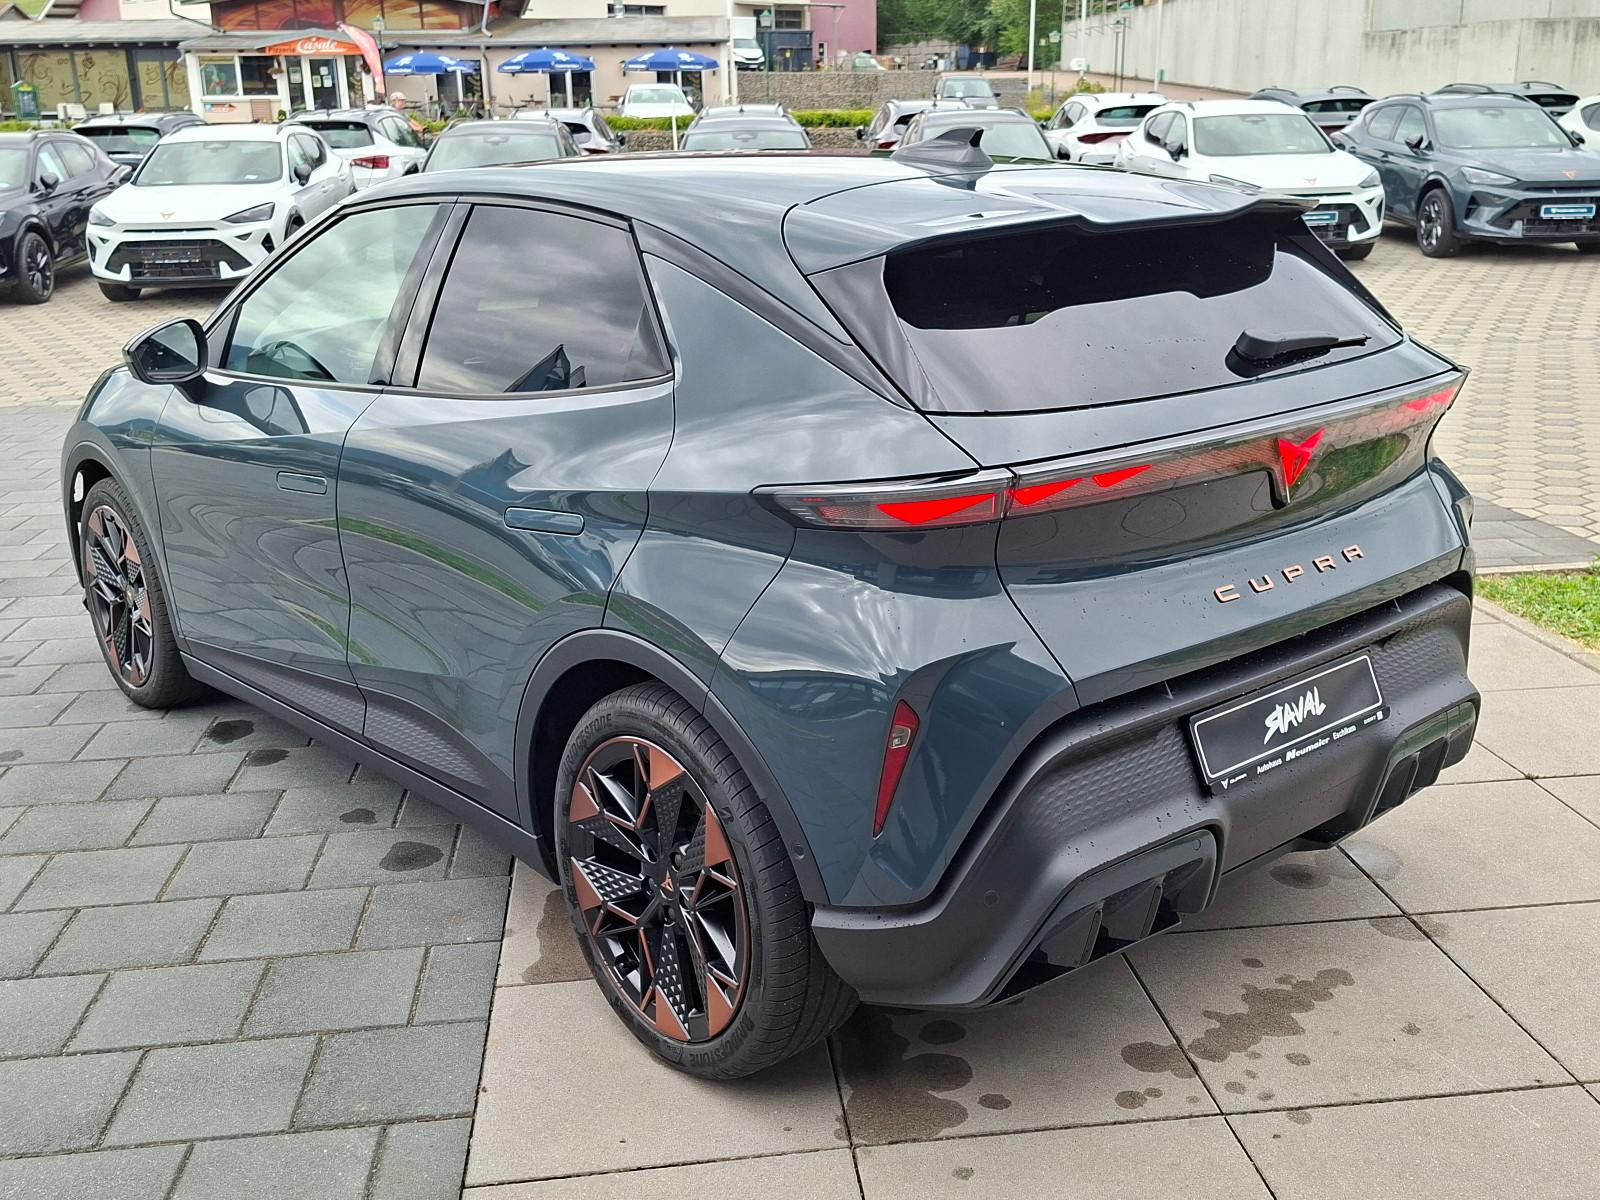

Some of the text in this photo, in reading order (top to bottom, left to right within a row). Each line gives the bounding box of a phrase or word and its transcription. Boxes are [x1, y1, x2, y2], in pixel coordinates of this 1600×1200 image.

[297, 37, 340, 54] Casale
[1213, 544, 1365, 604] CUPRA
[561, 713, 613, 777] BRIDGESTONE
[1263, 686, 1327, 745] RAVAL
[1256, 757, 1283, 775] Autohaus
[1285, 736, 1331, 762] Neumaier
